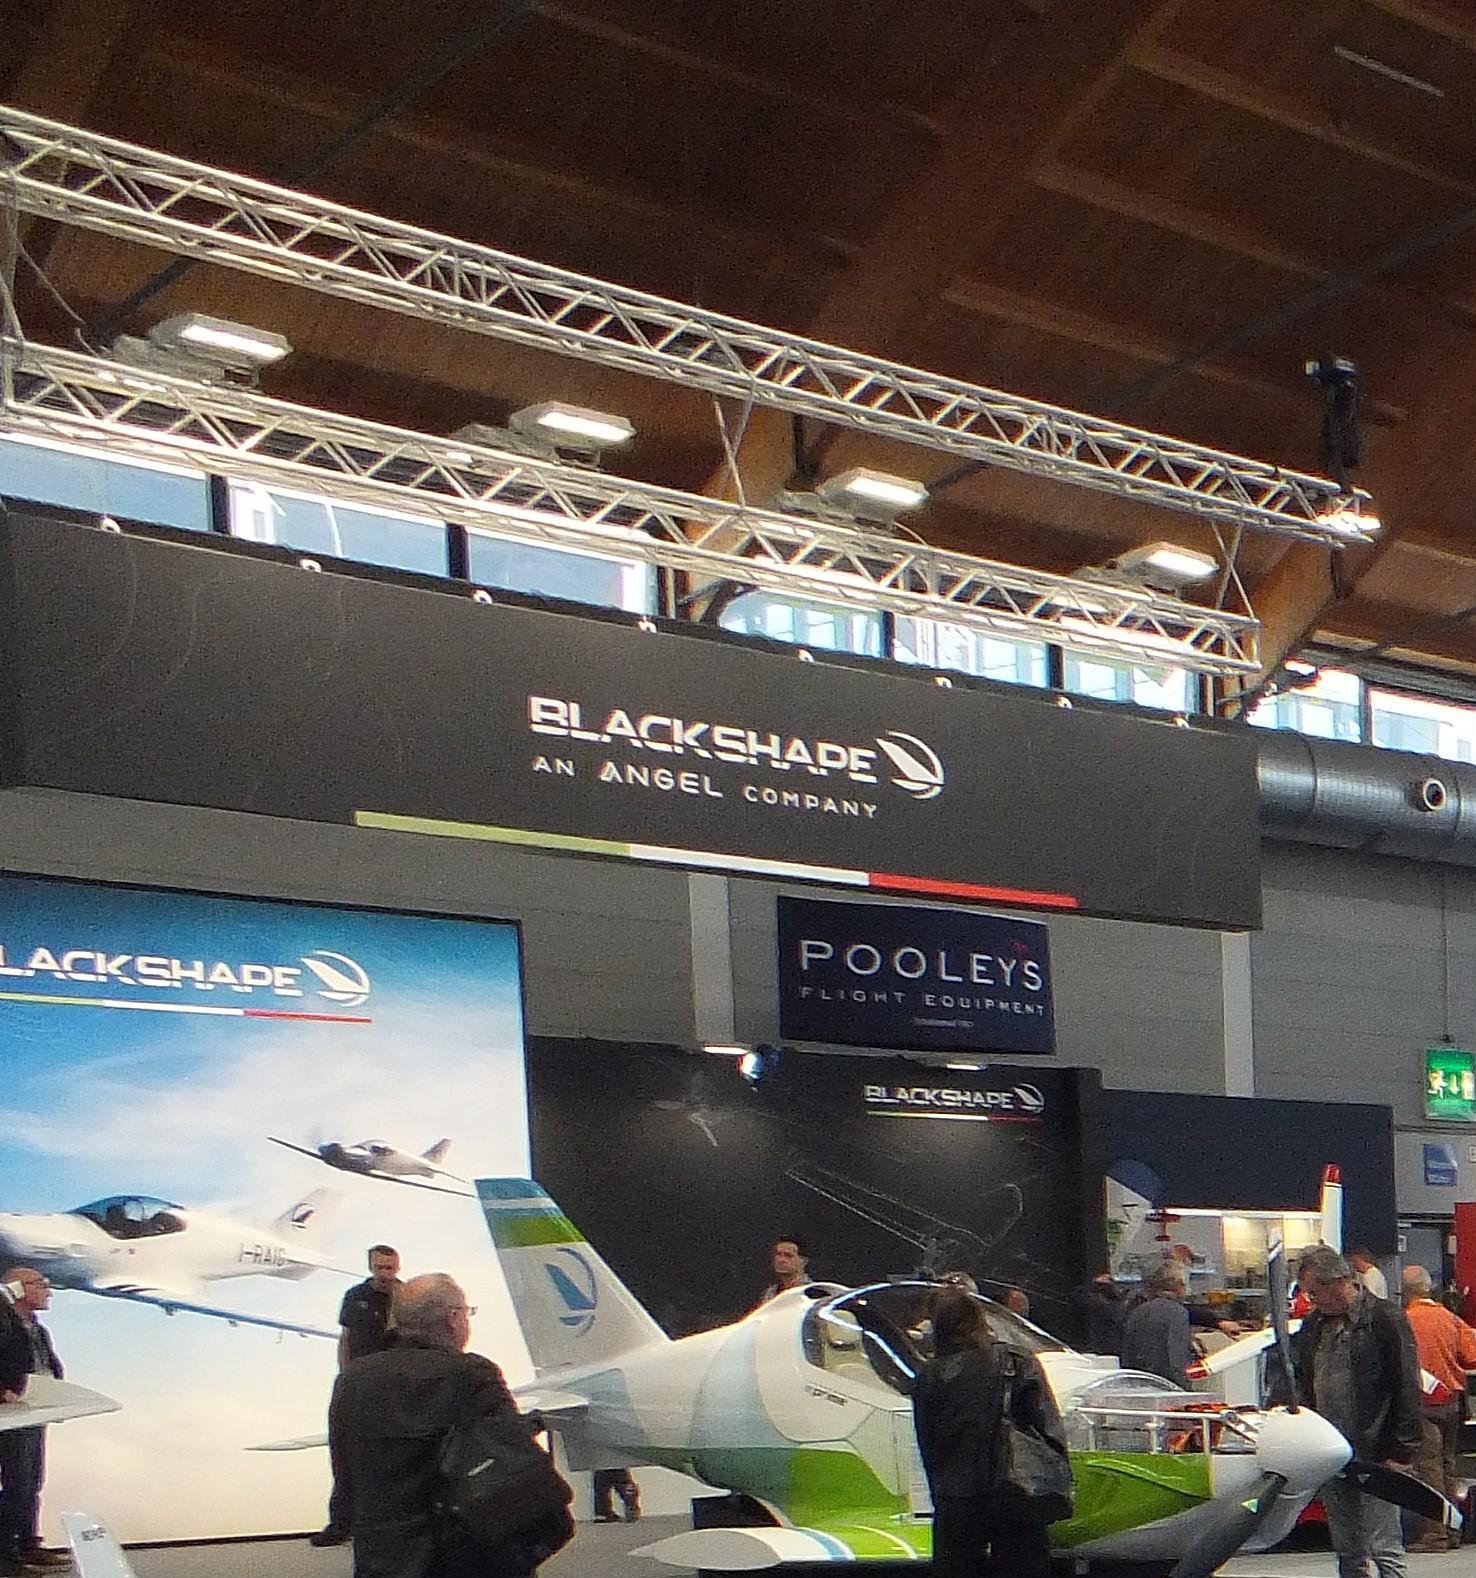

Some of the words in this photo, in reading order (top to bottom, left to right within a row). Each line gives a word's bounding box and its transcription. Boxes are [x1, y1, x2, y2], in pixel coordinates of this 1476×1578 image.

[529, 695, 880, 785] BLACKSHAPE
[532, 755, 575, 777] AN
[599, 761, 724, 798] ANGEL
[743, 784, 879, 819] COMPANY
[799, 938, 1044, 992] POOLEYS
[799, 986, 907, 1002] FLIGHT
[924, 994, 1046, 1017] EQUIPMENT
[863, 1074, 1015, 1109] BLACKSHAPE
